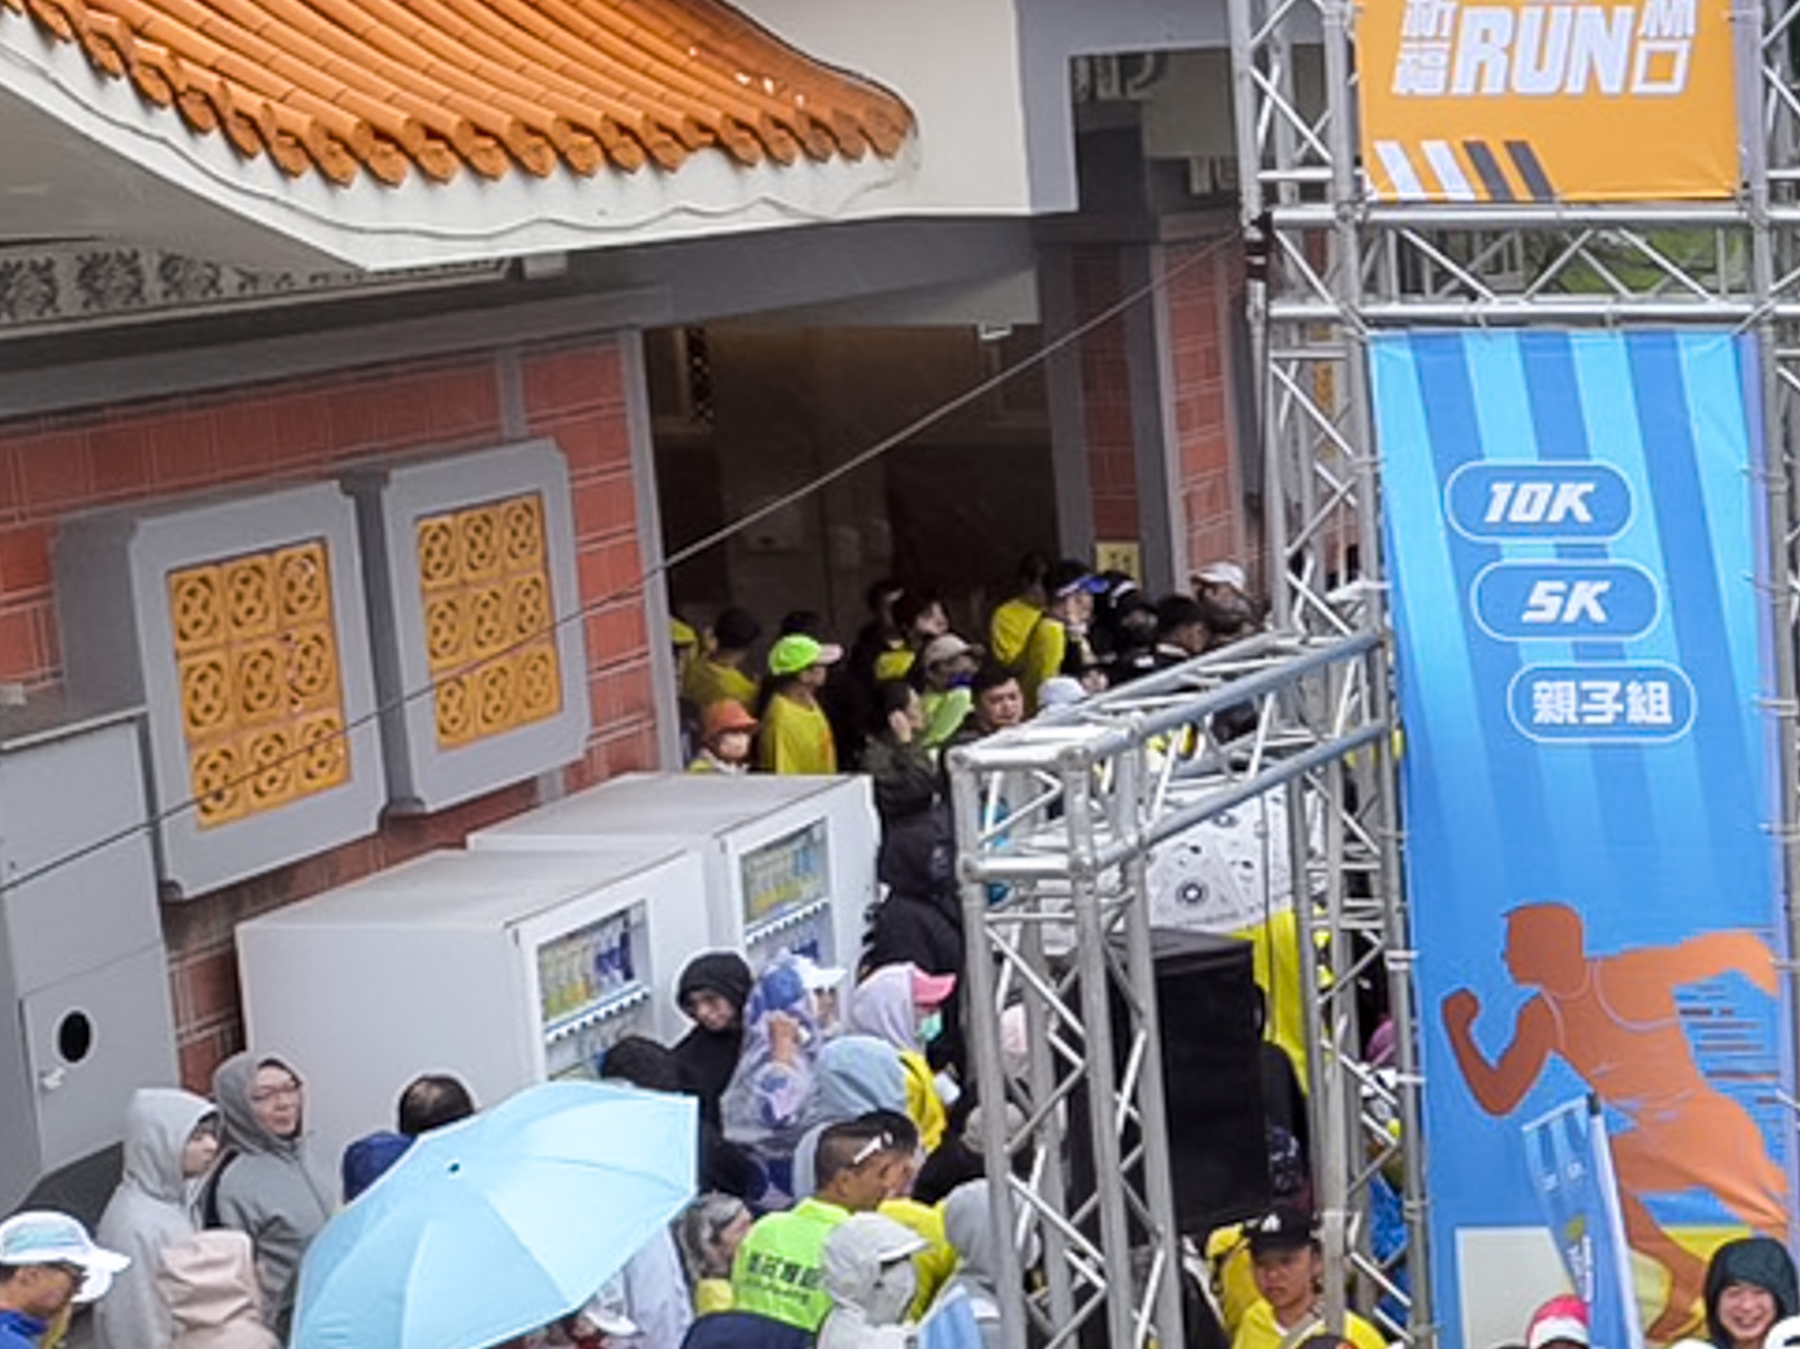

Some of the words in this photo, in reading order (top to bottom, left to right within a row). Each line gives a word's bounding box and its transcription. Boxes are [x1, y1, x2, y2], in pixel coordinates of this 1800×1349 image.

[1451, 5, 1635, 95] RUN
[1484, 482, 1595, 523] 10K
[1521, 580, 1611, 623] 5K
[1532, 680, 1673, 724] 親子組
